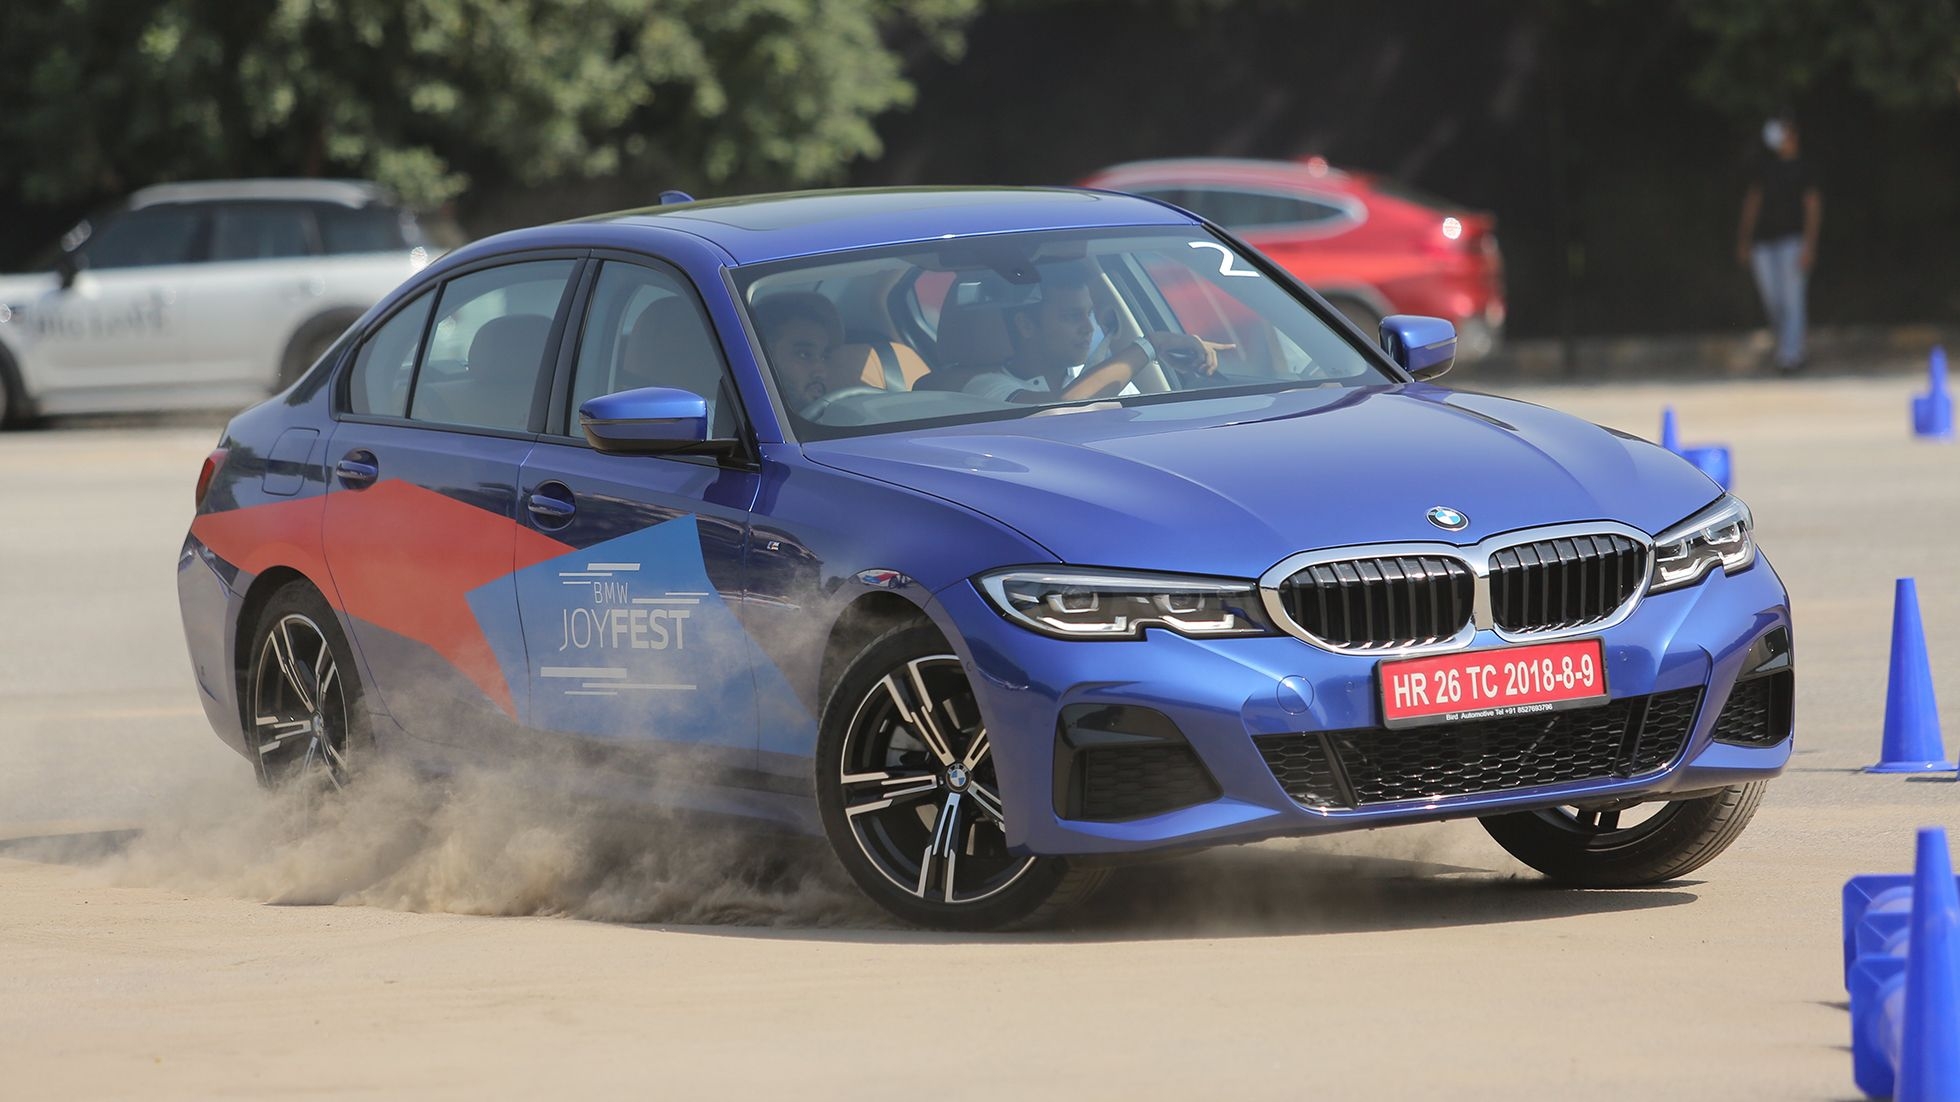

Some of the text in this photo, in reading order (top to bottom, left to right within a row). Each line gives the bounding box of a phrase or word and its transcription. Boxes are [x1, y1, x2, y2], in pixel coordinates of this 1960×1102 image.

[1187, 241, 1260, 277] 2
[593, 582, 628, 604] BMW
[559, 608, 690, 651] JOYFEST
[1393, 653, 1595, 709] HR 26 TC 2018-8-9
[1461, 710, 1494, 719] Automotive
[1495, 708, 1504, 716] Tel
[1505, 707, 1516, 715] +91
